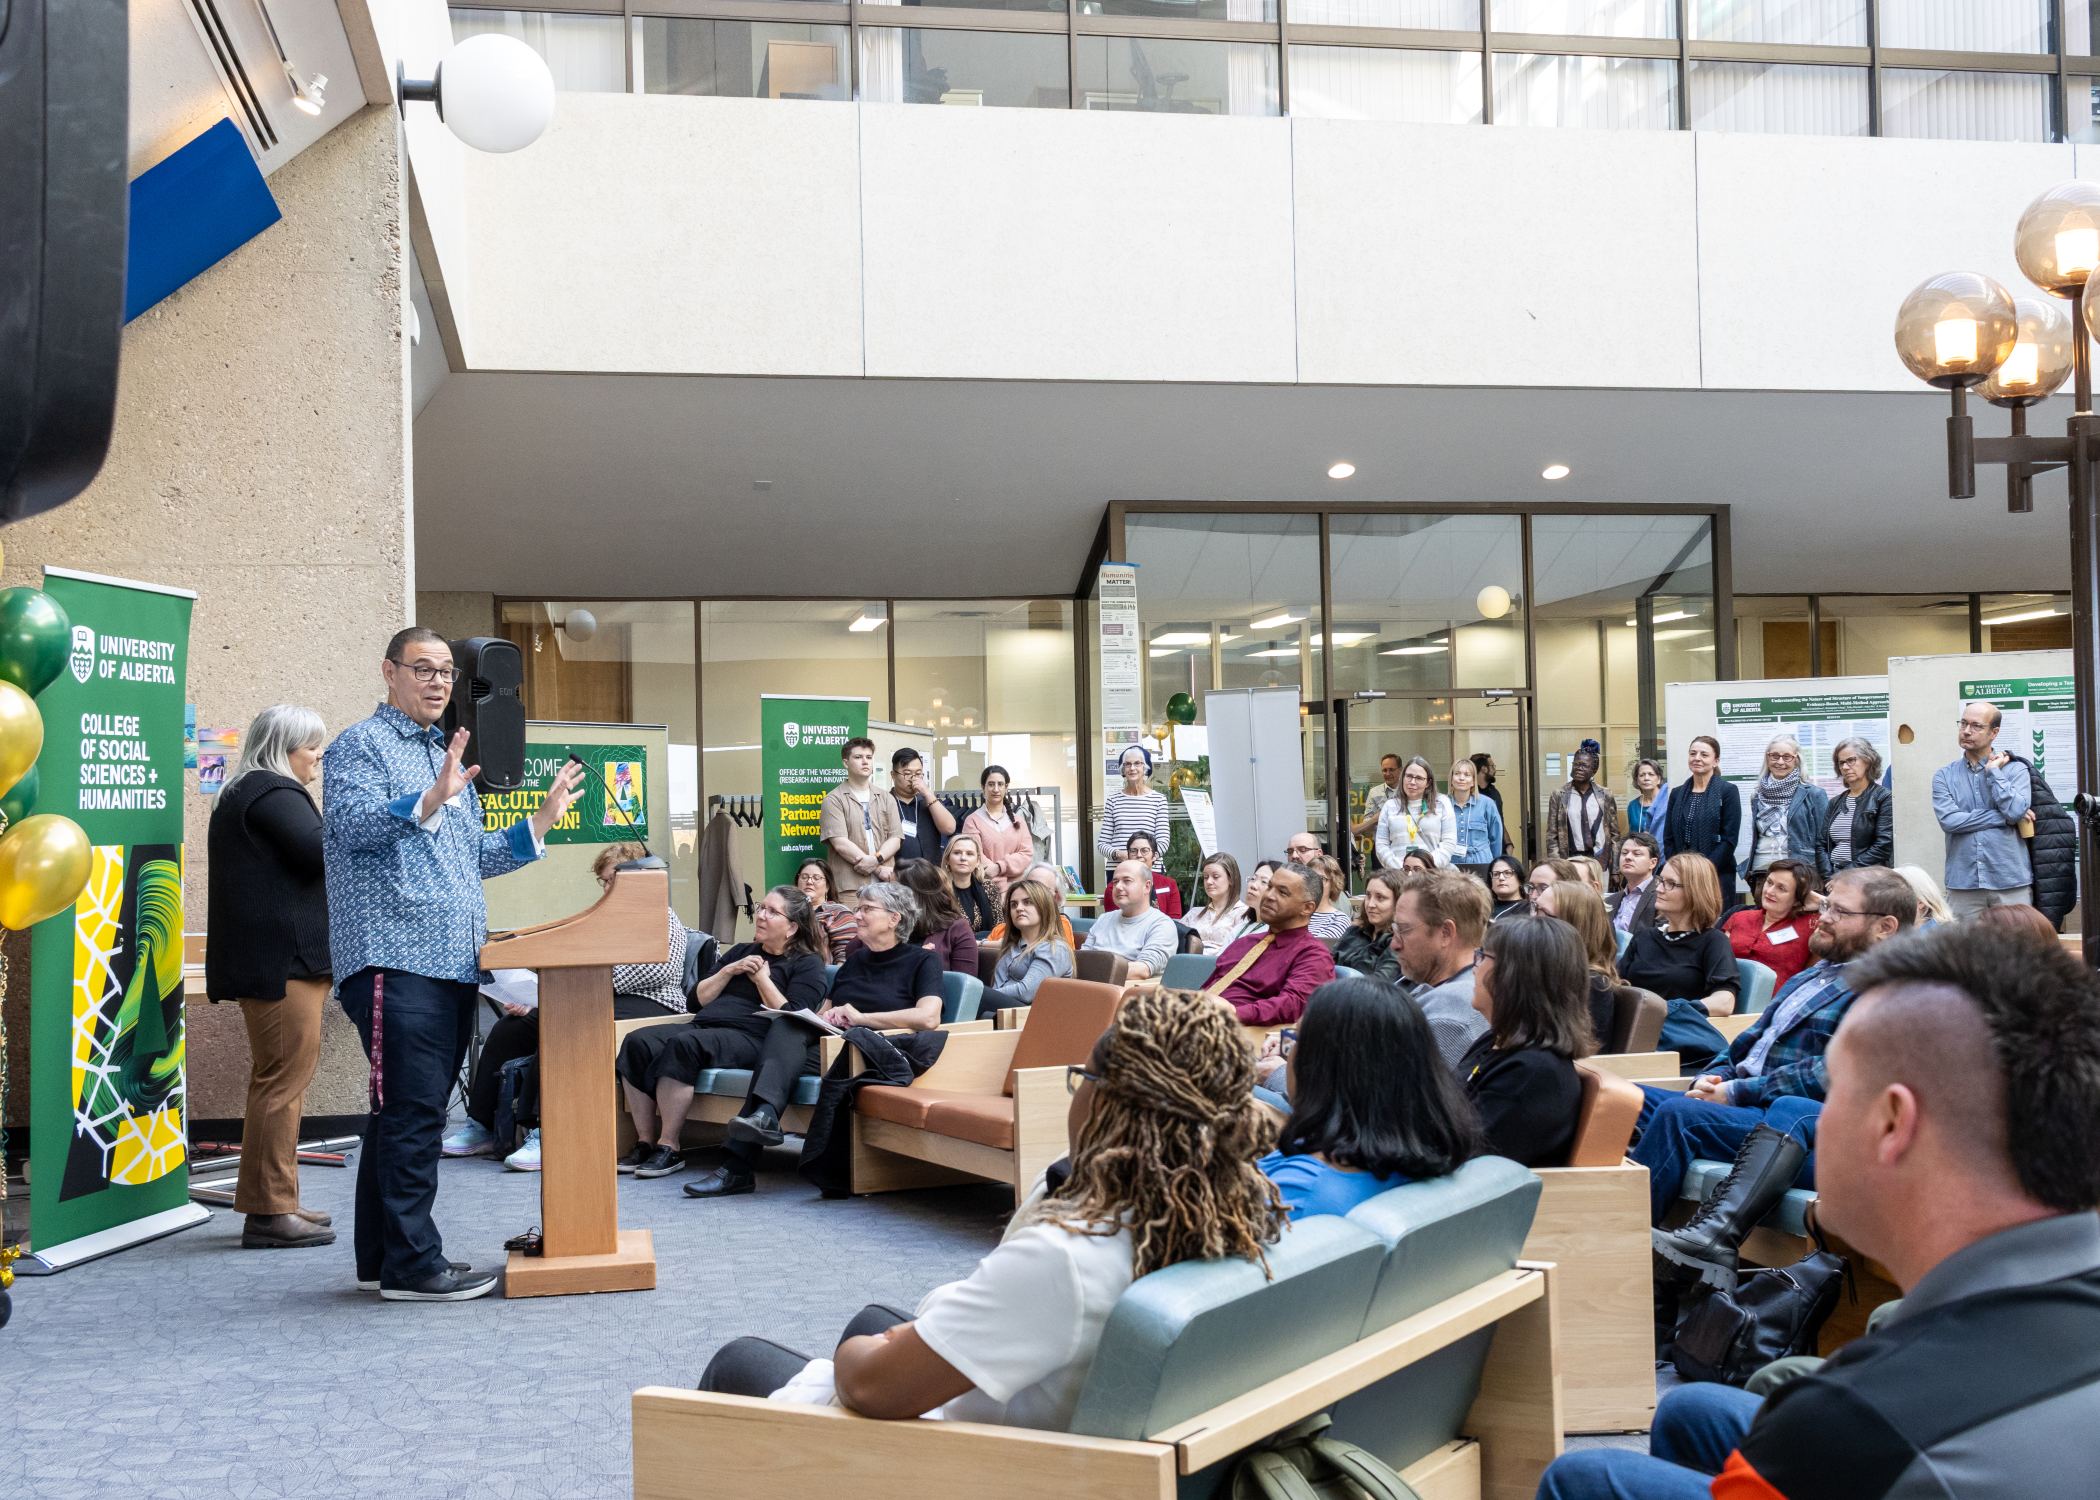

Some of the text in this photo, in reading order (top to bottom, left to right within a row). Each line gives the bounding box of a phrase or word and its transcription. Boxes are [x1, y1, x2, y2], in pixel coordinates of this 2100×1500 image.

[99, 634, 175, 661] UNIVERSITY
[99, 660, 176, 685] OF ALBERTA
[1974, 688, 2013, 696] ALBERTA
[80, 713, 140, 738] COLLEGE
[802, 725, 850, 735] UNIVERSITY
[803, 736, 813, 744] OF
[80, 738, 150, 761] OF SOCIAL
[524, 758, 562, 776] COME
[80, 764, 146, 785] SCIENCES
[780, 776, 809, 784] (RESEARCH
[527, 779, 539, 787] THE
[79, 788, 166, 810] HUMANITIES
[780, 808, 821, 820] Partner
[781, 824, 820, 836] Networ
[782, 844, 813, 852] uab.ca/rpnet
